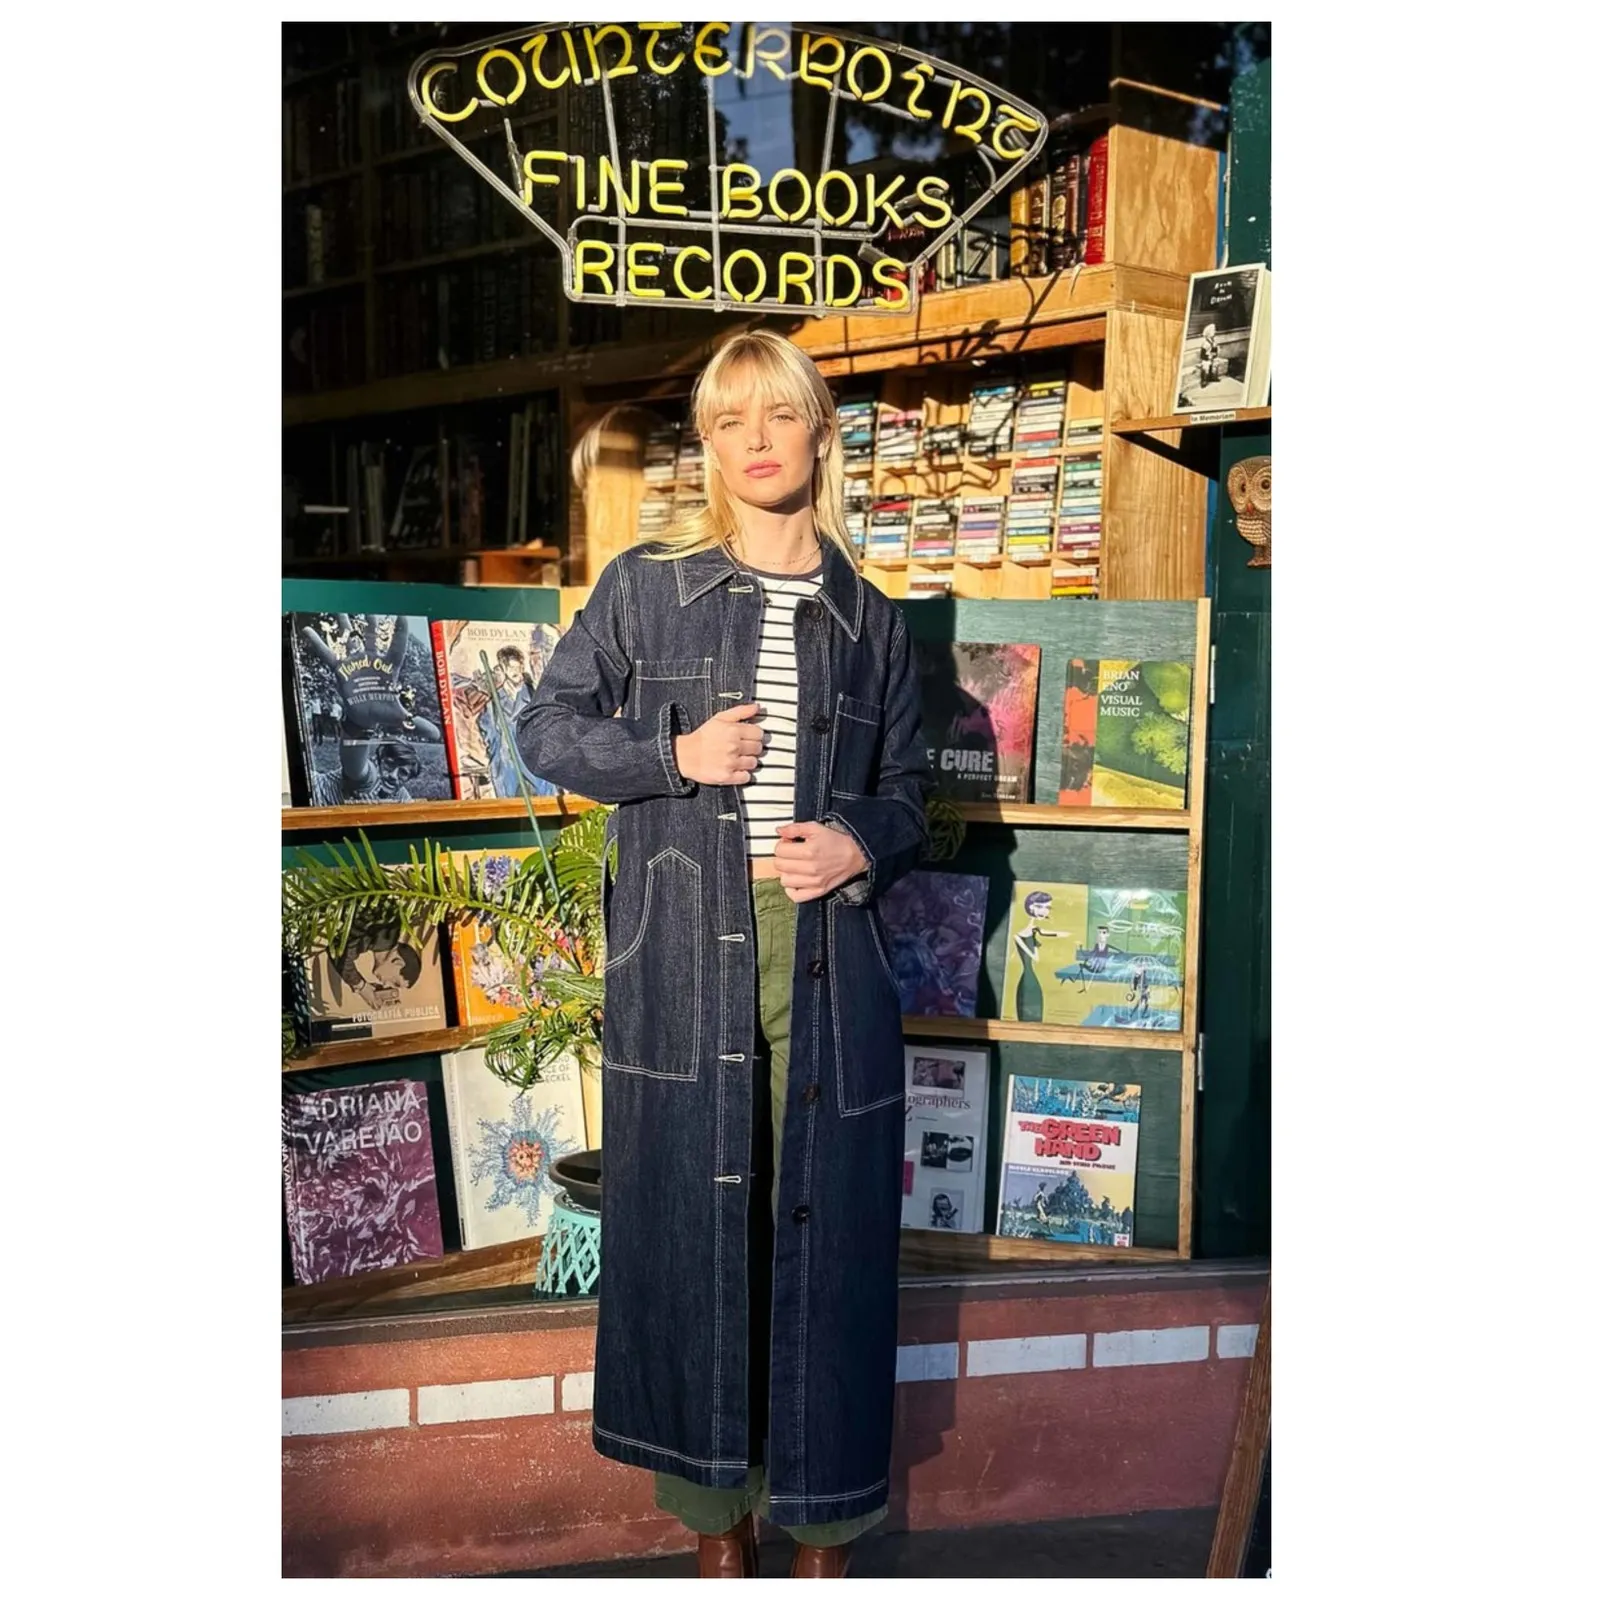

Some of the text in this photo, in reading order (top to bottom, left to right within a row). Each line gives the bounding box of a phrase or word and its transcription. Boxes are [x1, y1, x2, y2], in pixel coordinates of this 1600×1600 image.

[522, 150, 954, 230] FINE BOOKS
[572, 240, 911, 311] RECORDS
[467, 628, 527, 638] BOB DYLAN
[436, 650, 452, 725] BOB DYLAN
[1103, 671, 1140, 681] BRIAN
[1104, 681, 1128, 692] ENO
[1100, 695, 1143, 706] VISUAL
[1100, 707, 1140, 718] MUSIC
[940, 748, 994, 772] CURE
[963, 773, 993, 781] PERFECT
[303, 1090, 420, 1121] ADRIANA
[907, 1095, 971, 1109] ographers
[302, 1119, 422, 1155] VAREJÃO
[1042, 1118, 1121, 1146] GREEN
[1034, 1138, 1102, 1161] HAND
